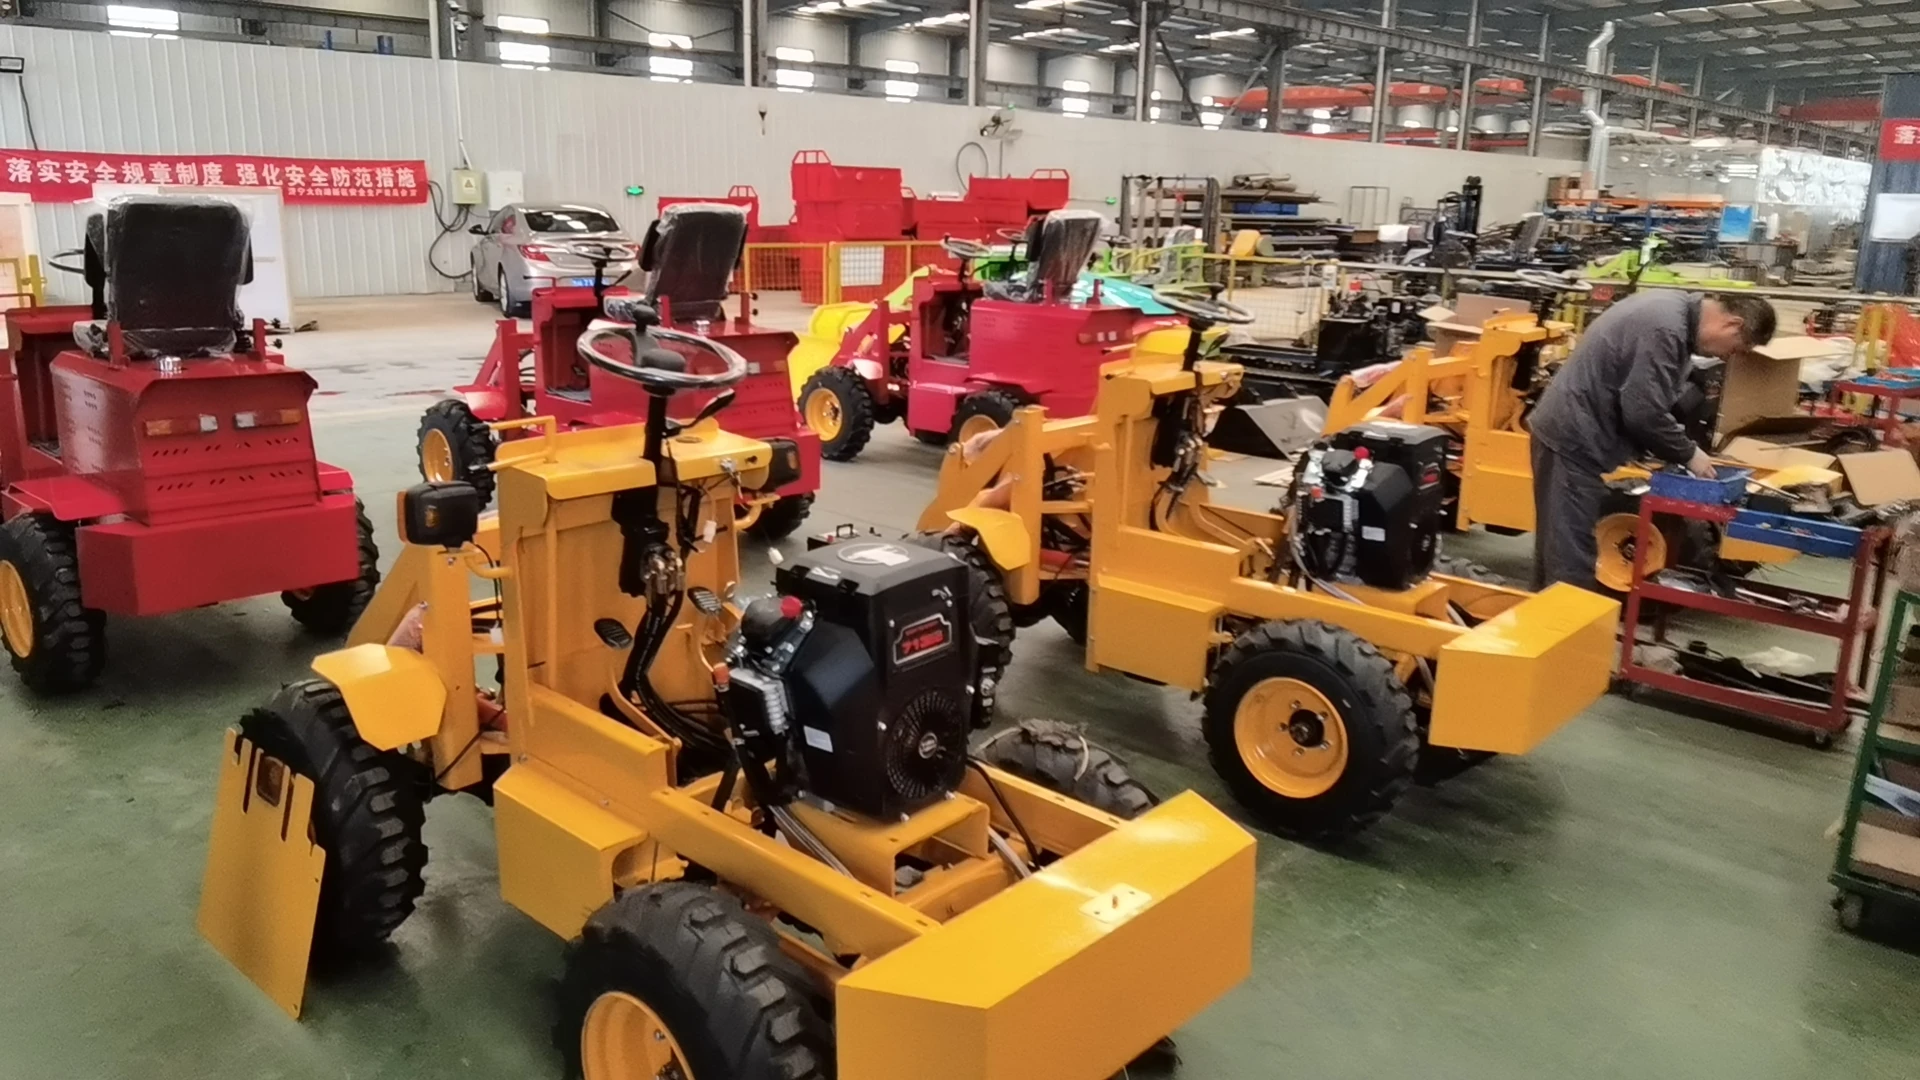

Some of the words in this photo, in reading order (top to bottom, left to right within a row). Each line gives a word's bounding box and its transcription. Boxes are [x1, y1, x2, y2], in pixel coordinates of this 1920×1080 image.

[6, 157, 224, 186] 落实安全规章制度
[236, 163, 417, 188] 强化安全防范措施
